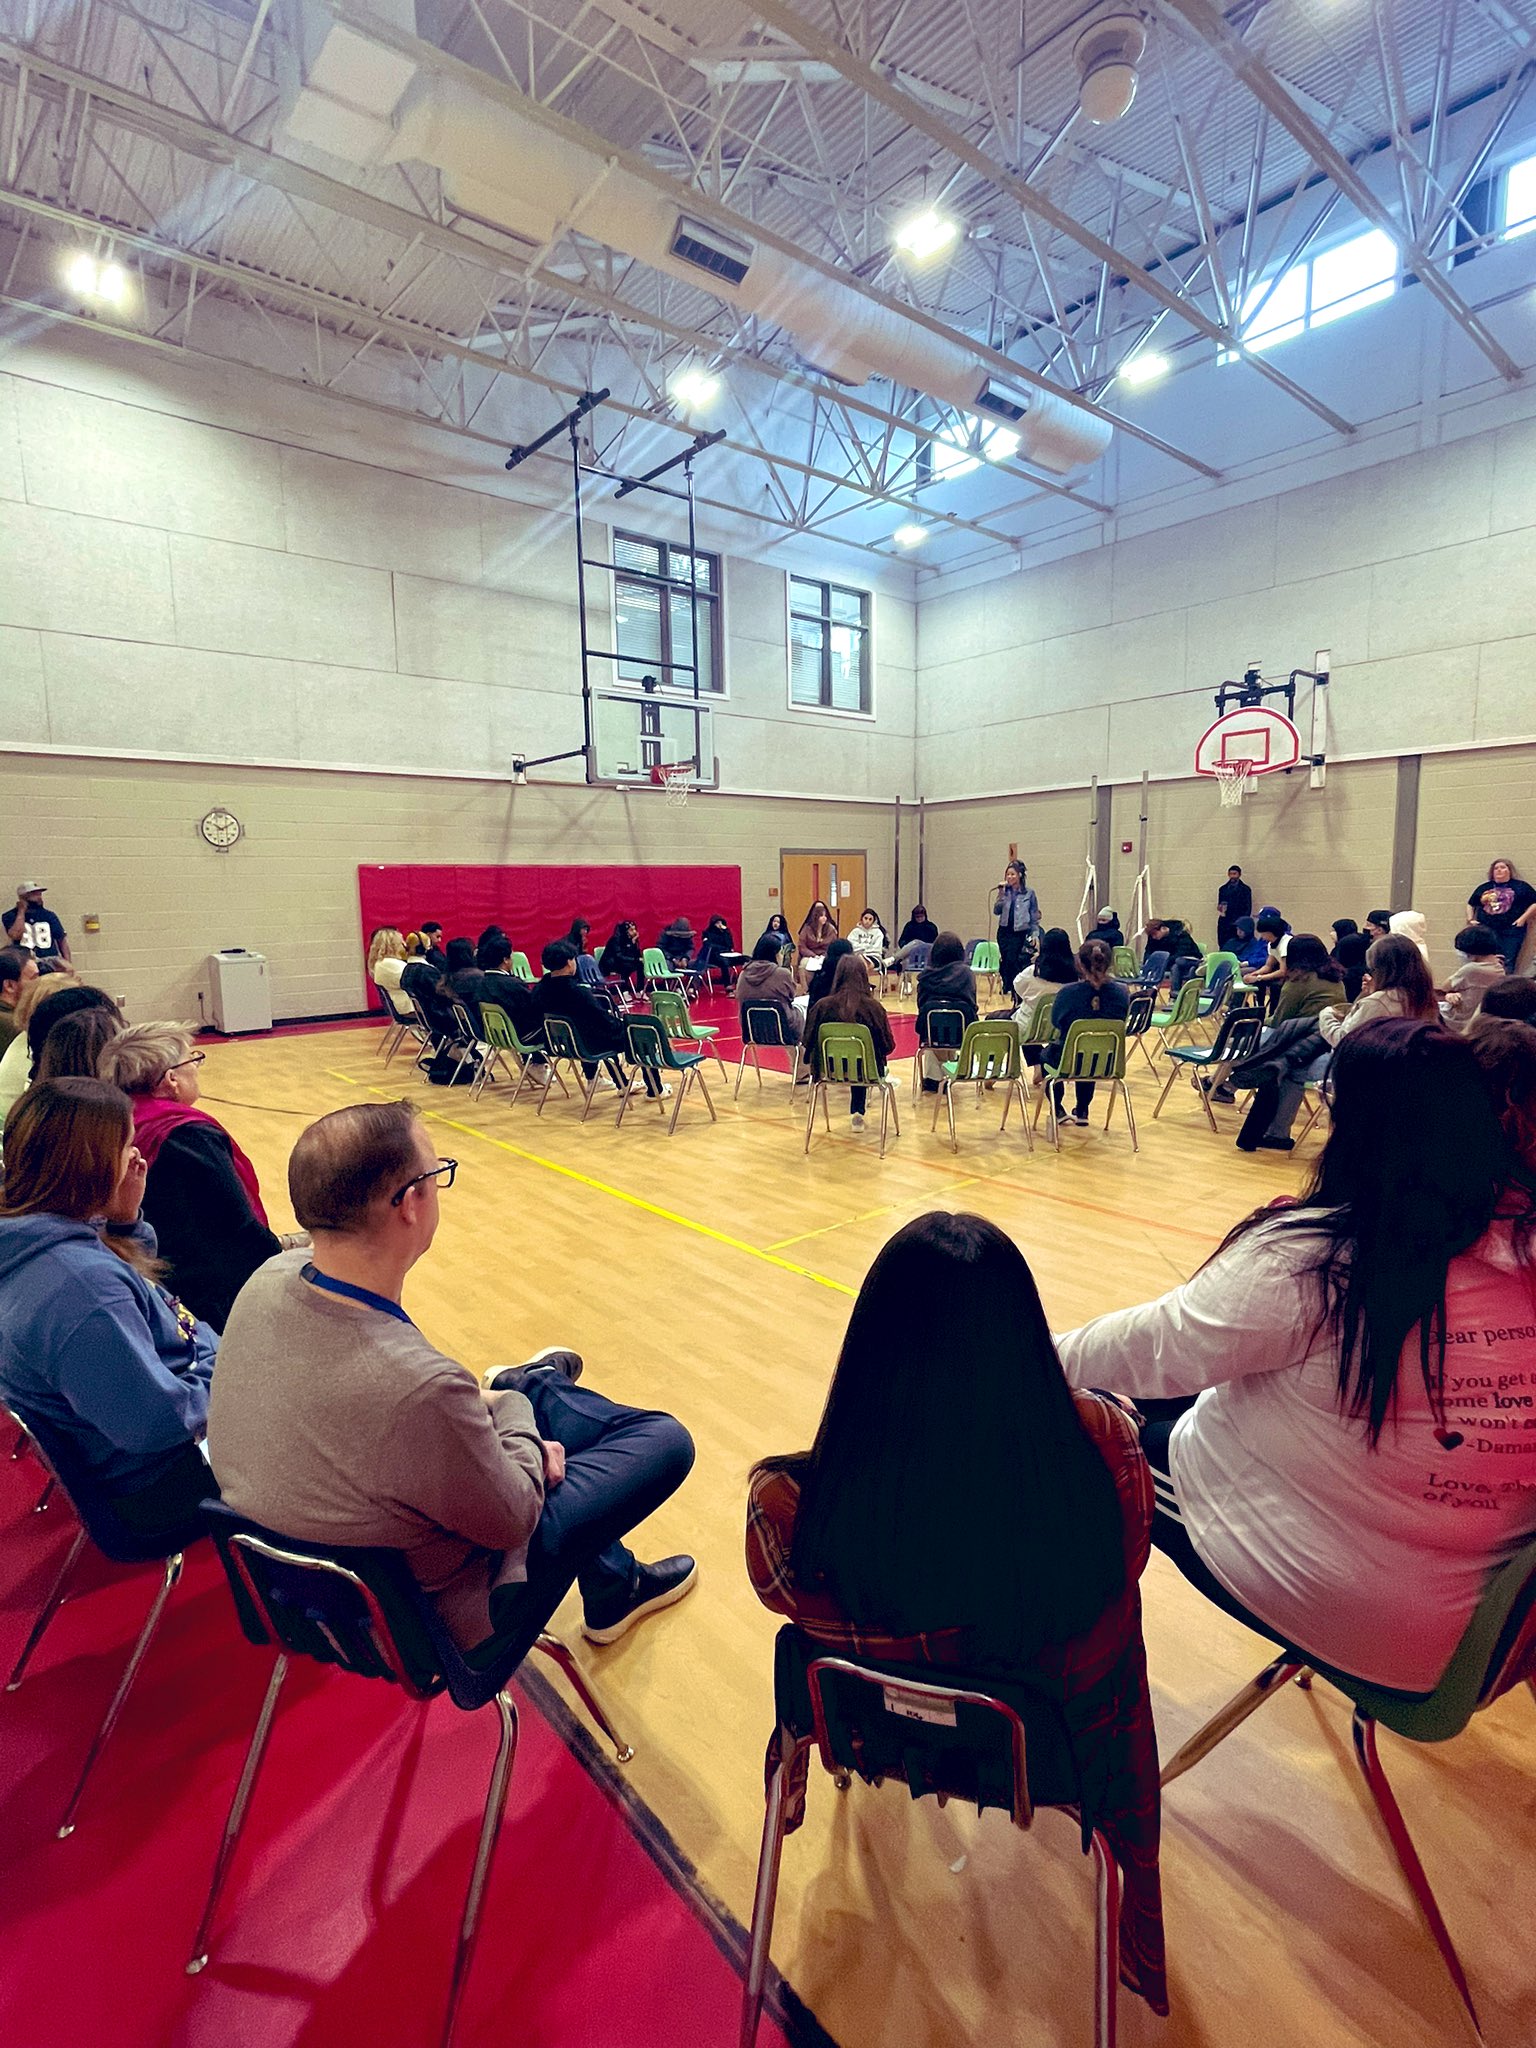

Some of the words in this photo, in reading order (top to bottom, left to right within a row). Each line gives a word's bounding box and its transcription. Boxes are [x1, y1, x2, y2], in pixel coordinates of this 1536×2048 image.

[1482, 1326, 1536, 1347] perso
[1452, 1376, 1493, 1392] you
[1498, 1373, 1526, 1390] get
[1435, 1396, 1488, 1408] ome
[1492, 1391, 1534, 1409] love
[1458, 1415, 1518, 1430] won't
[1423, 1492, 1453, 1504] of
